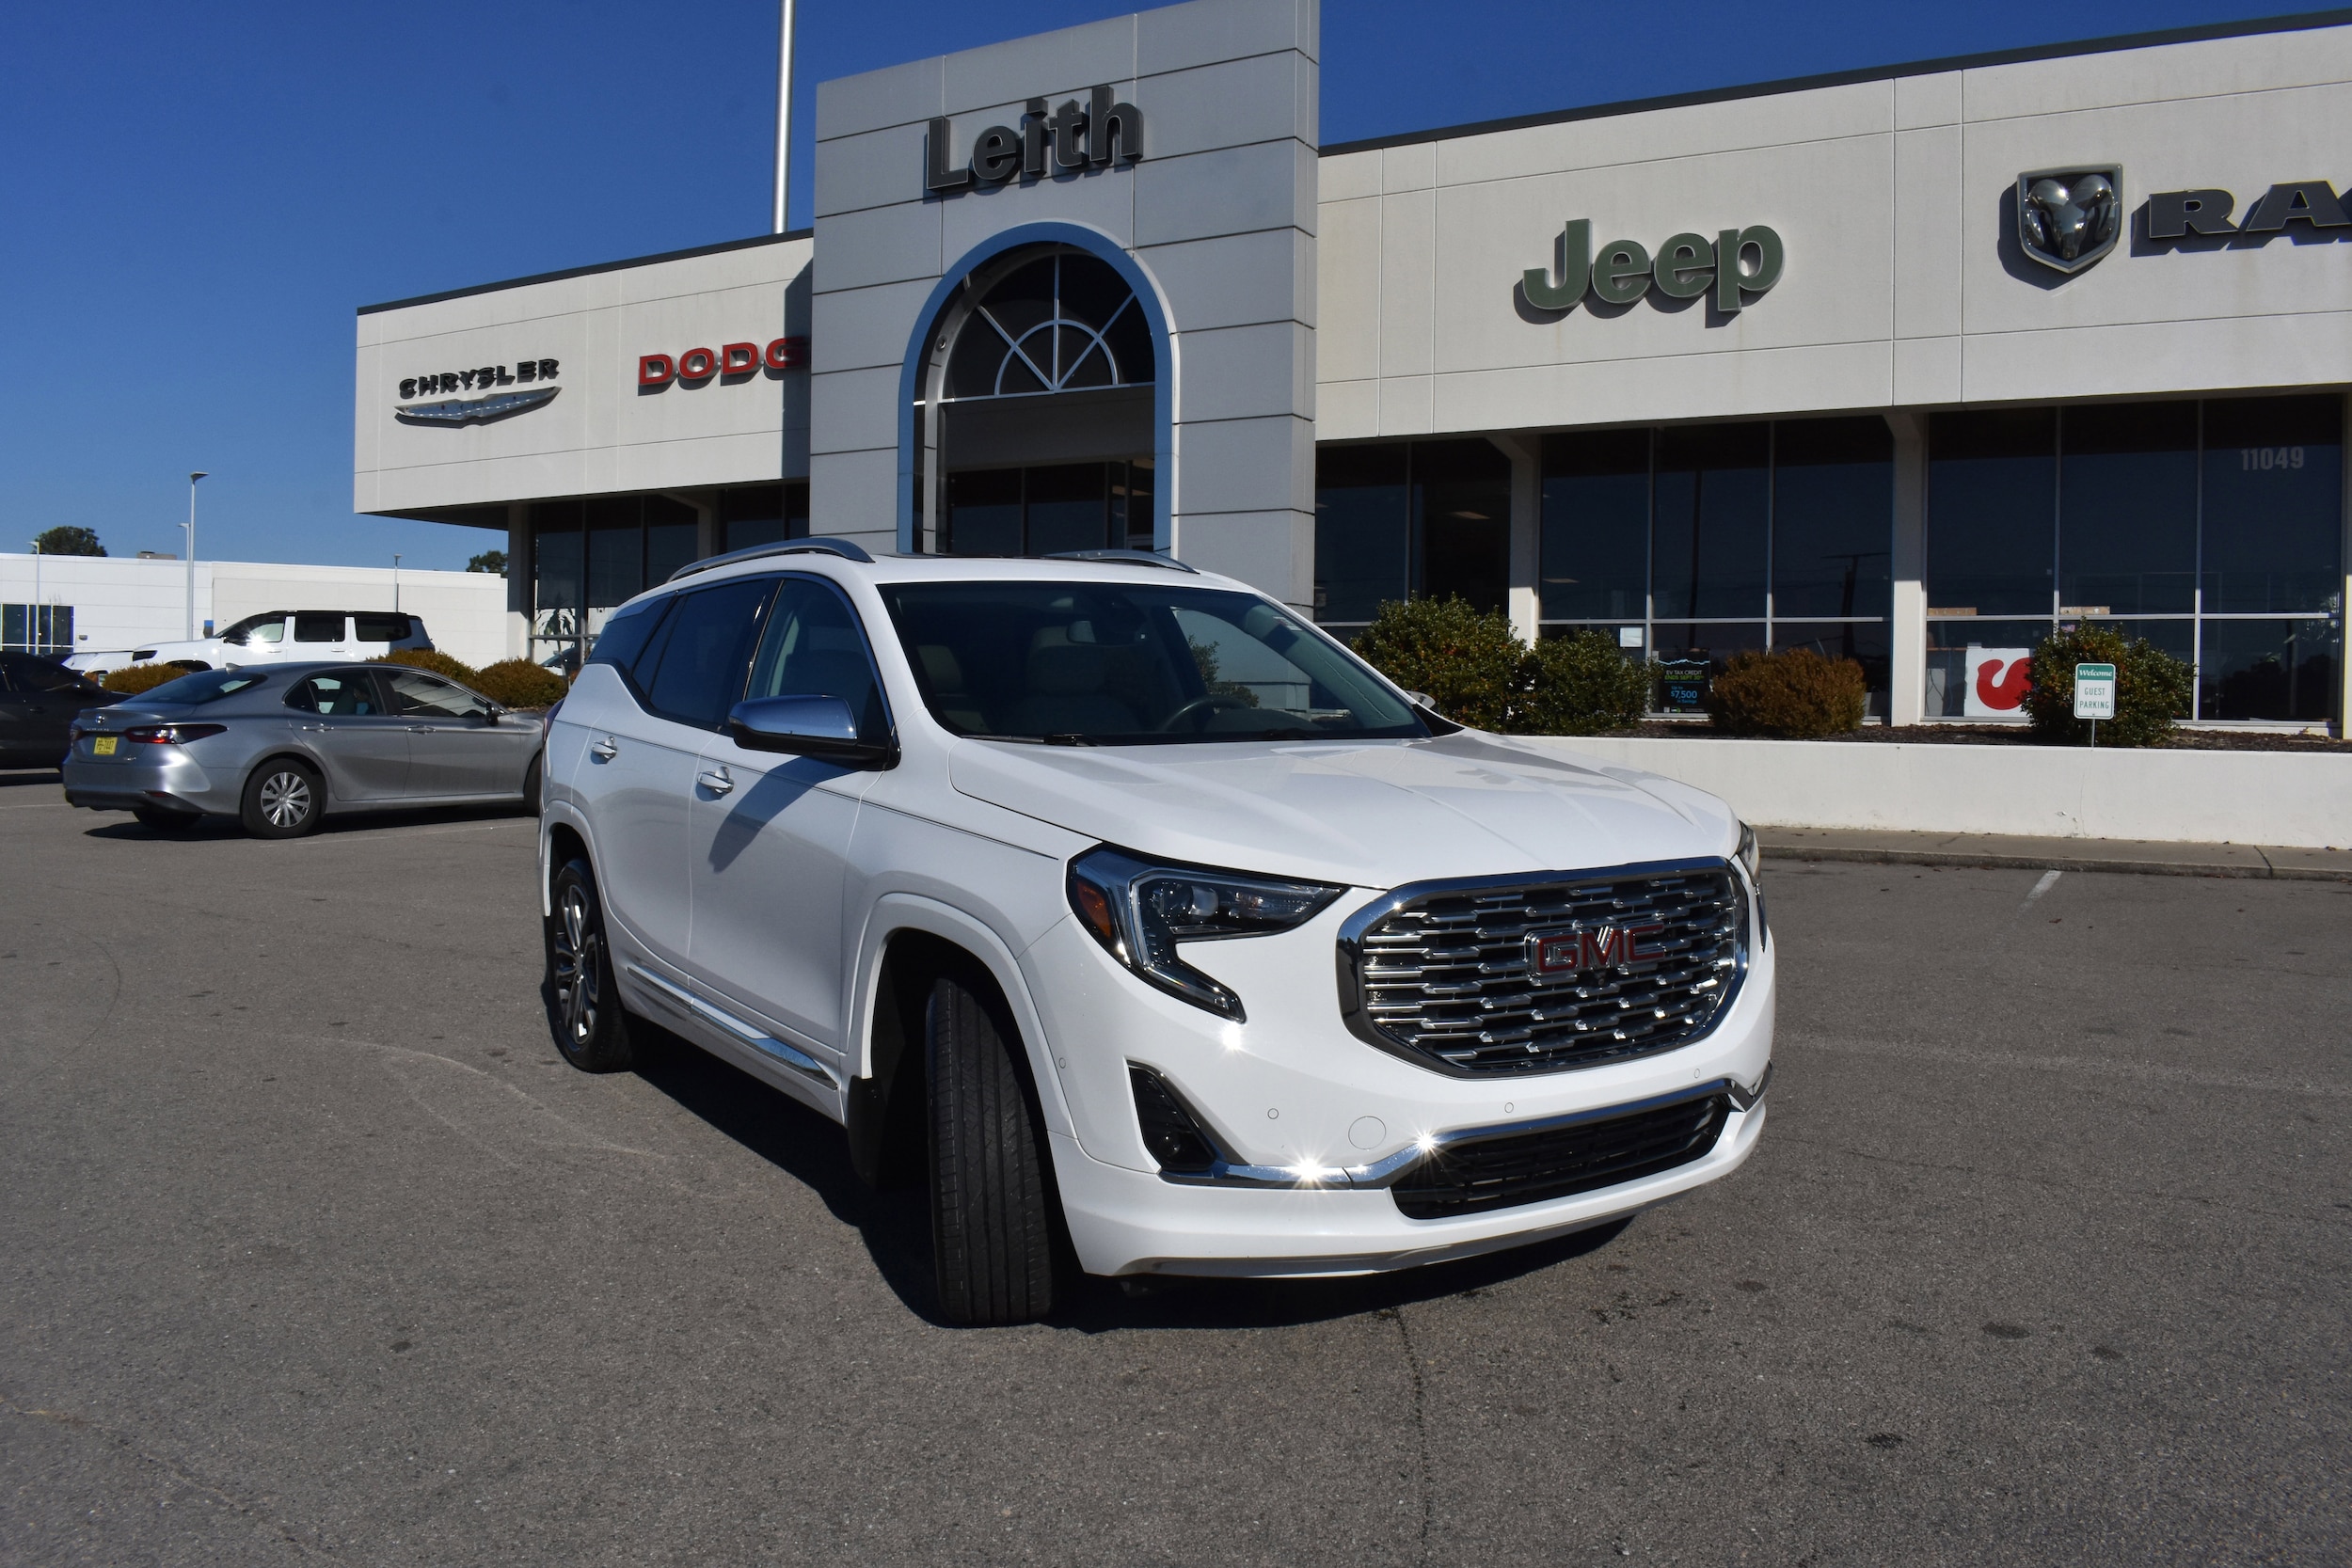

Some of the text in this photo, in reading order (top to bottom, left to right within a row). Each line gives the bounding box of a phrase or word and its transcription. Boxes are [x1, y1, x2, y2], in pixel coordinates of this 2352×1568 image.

[926, 85, 1143, 190] Leith
[2148, 179, 2352, 239] RA
[1522, 217, 1785, 313] Jeep
[398, 357, 561, 395] CHRYSLER
[638, 336, 812, 386] DODG
[2240, 446, 2304, 470] 11049
[2079, 668, 2113, 677] Welcome
[2084, 687, 2106, 696] GUEST
[1670, 690, 1698, 699] $7,500
[2079, 700, 2110, 709] PARKING
[1534, 921, 1667, 975] GMC
